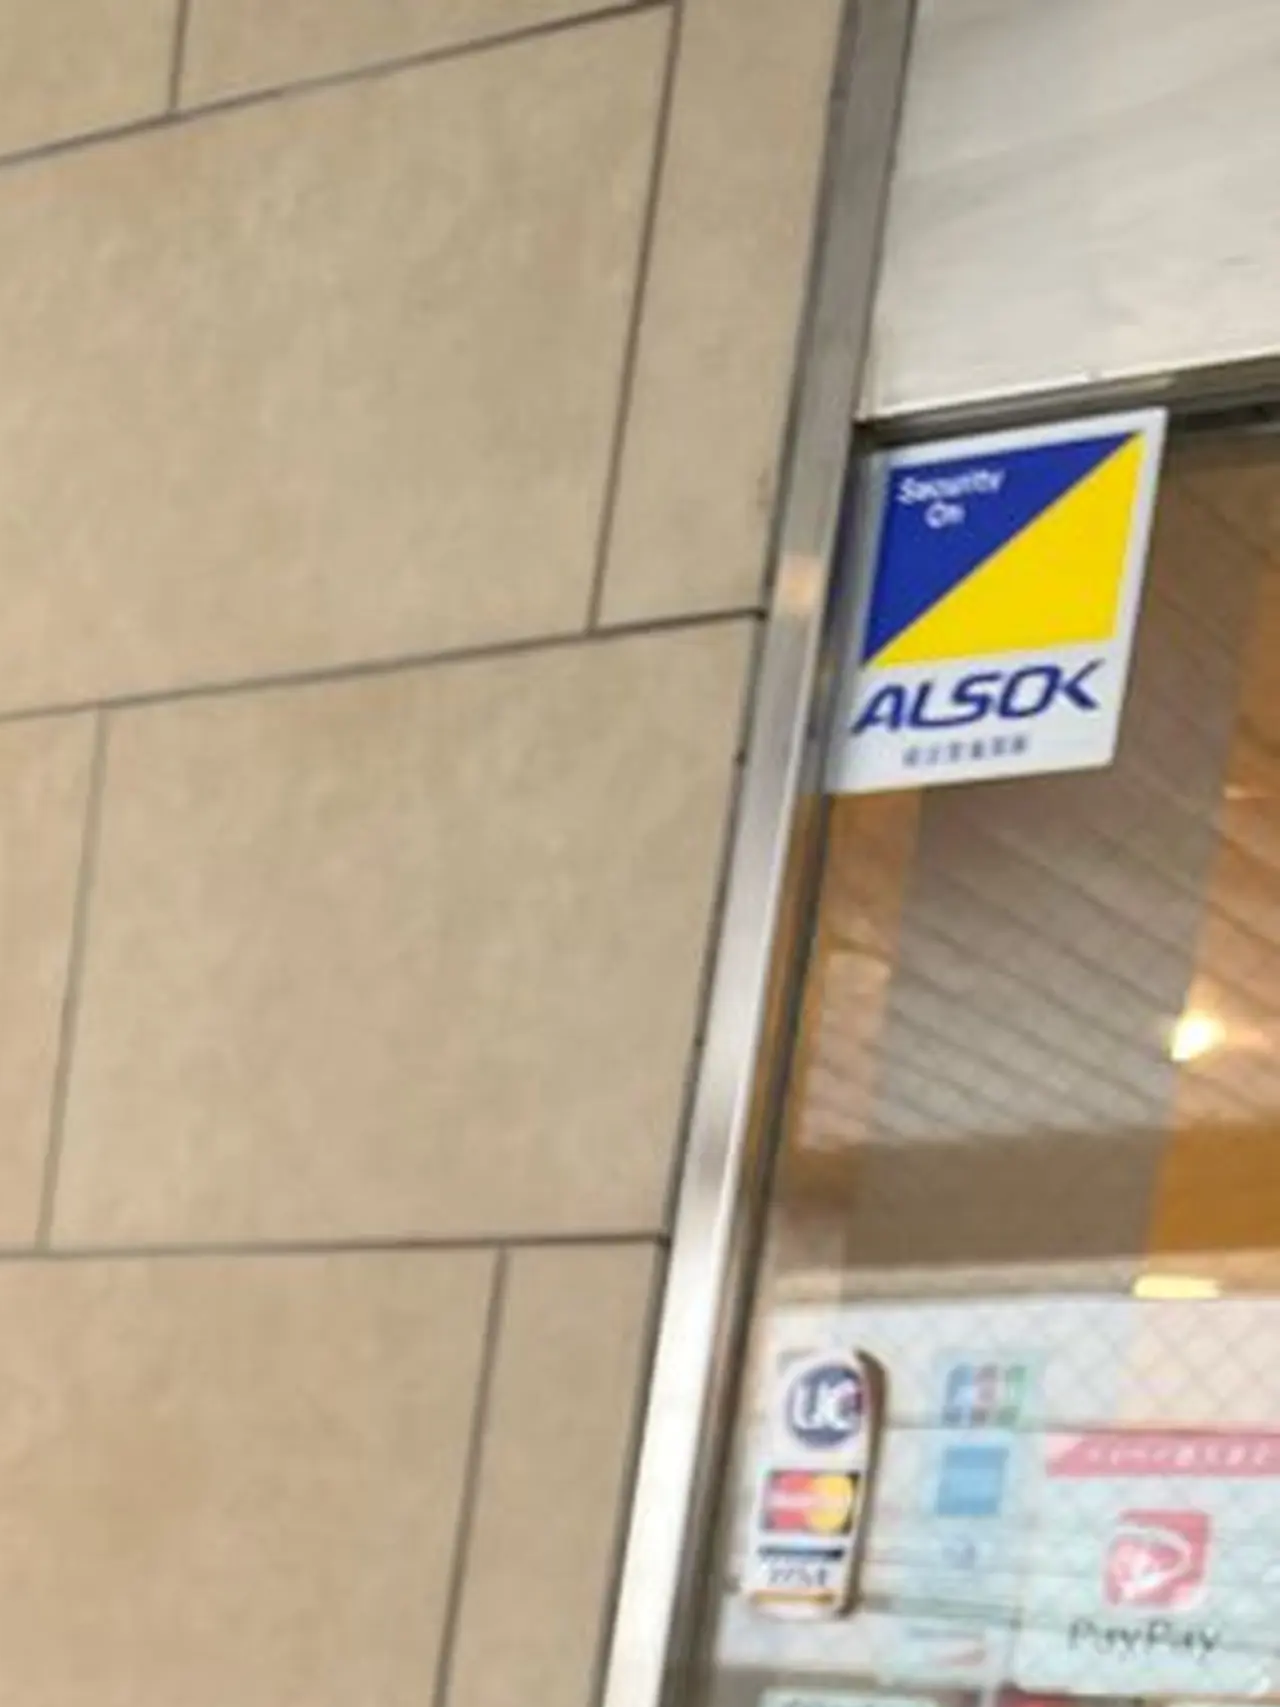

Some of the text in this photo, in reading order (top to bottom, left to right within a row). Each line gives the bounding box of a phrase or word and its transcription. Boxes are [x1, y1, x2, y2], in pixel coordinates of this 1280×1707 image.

[897, 470, 1004, 504] Security
[925, 502, 965, 528] On
[851, 660, 1103, 734] ALSOK
